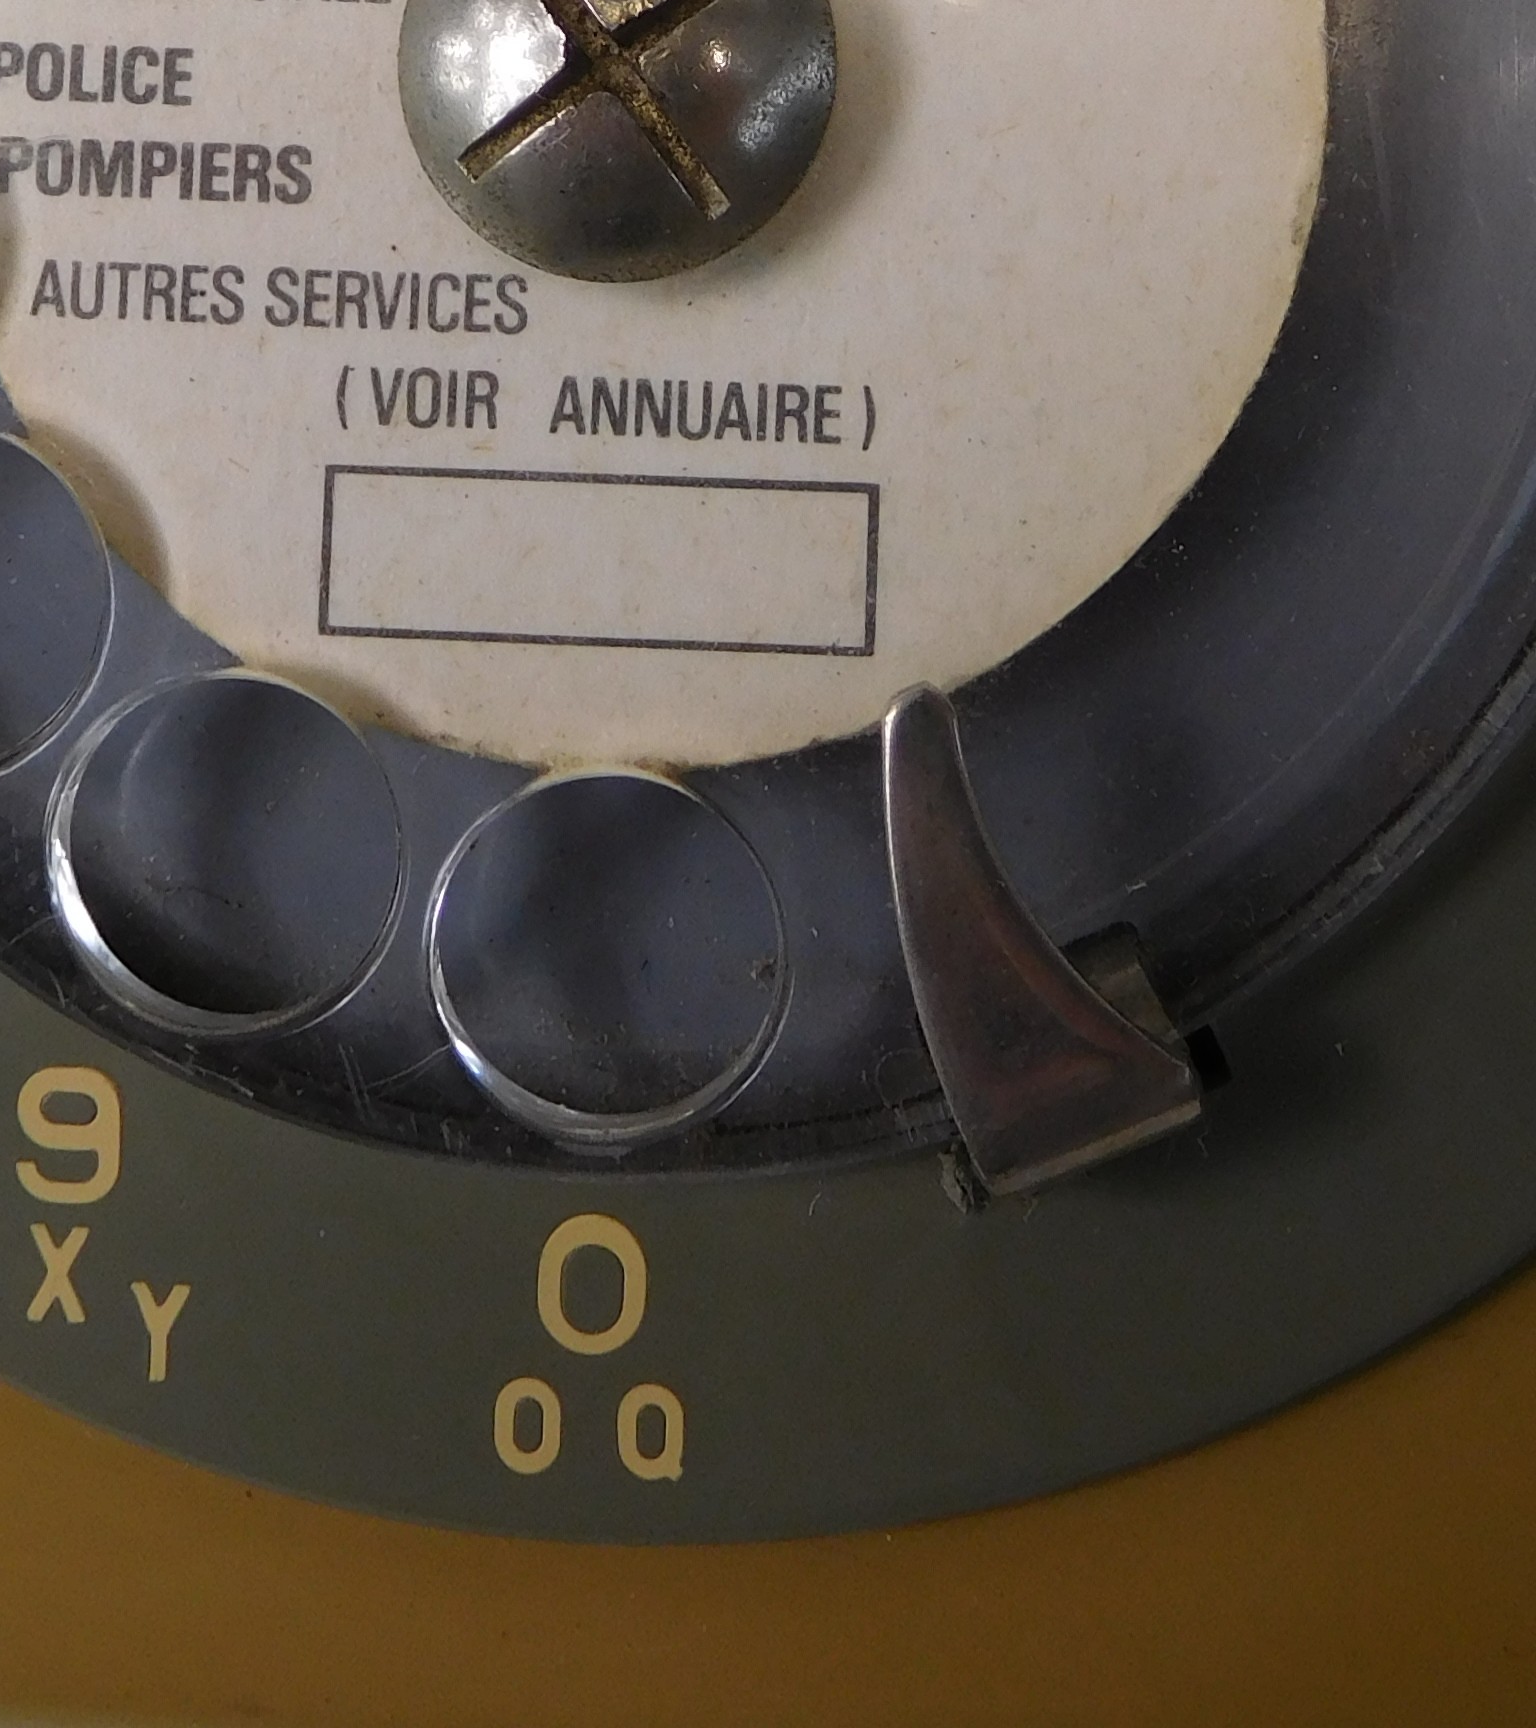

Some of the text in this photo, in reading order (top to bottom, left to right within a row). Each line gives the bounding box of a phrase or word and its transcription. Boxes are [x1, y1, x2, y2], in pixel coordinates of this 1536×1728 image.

[30, 259, 529, 334] AUTRES SERVICES
[15, 1065, 122, 1204] 9
